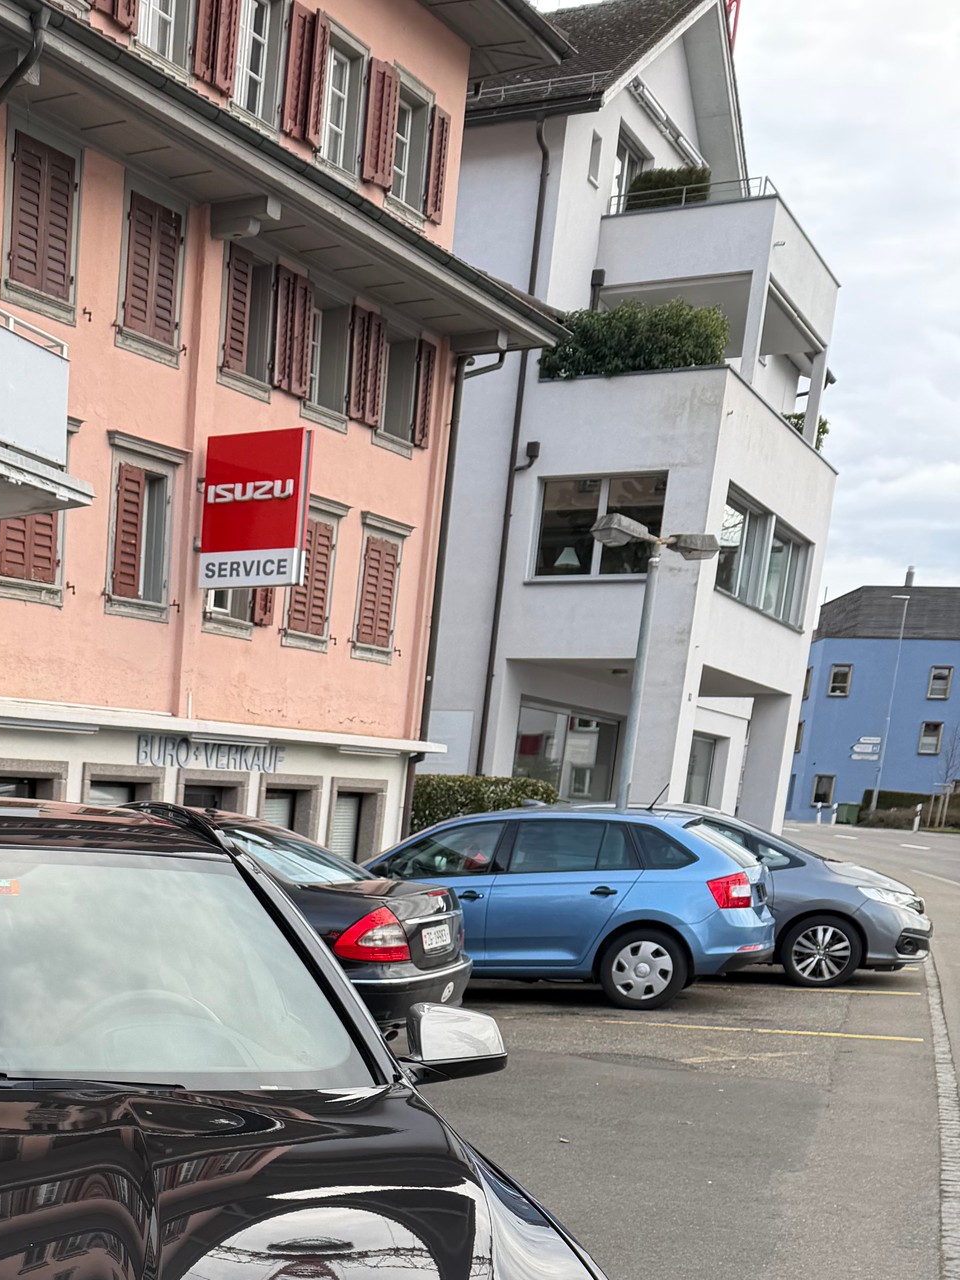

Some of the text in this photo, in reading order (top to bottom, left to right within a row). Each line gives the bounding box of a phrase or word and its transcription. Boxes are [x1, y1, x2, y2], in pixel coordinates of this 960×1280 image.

[207, 478, 294, 504] ISUZU
[204, 558, 288, 579] SERVICE
[204, 743, 287, 773] VERKAUF
